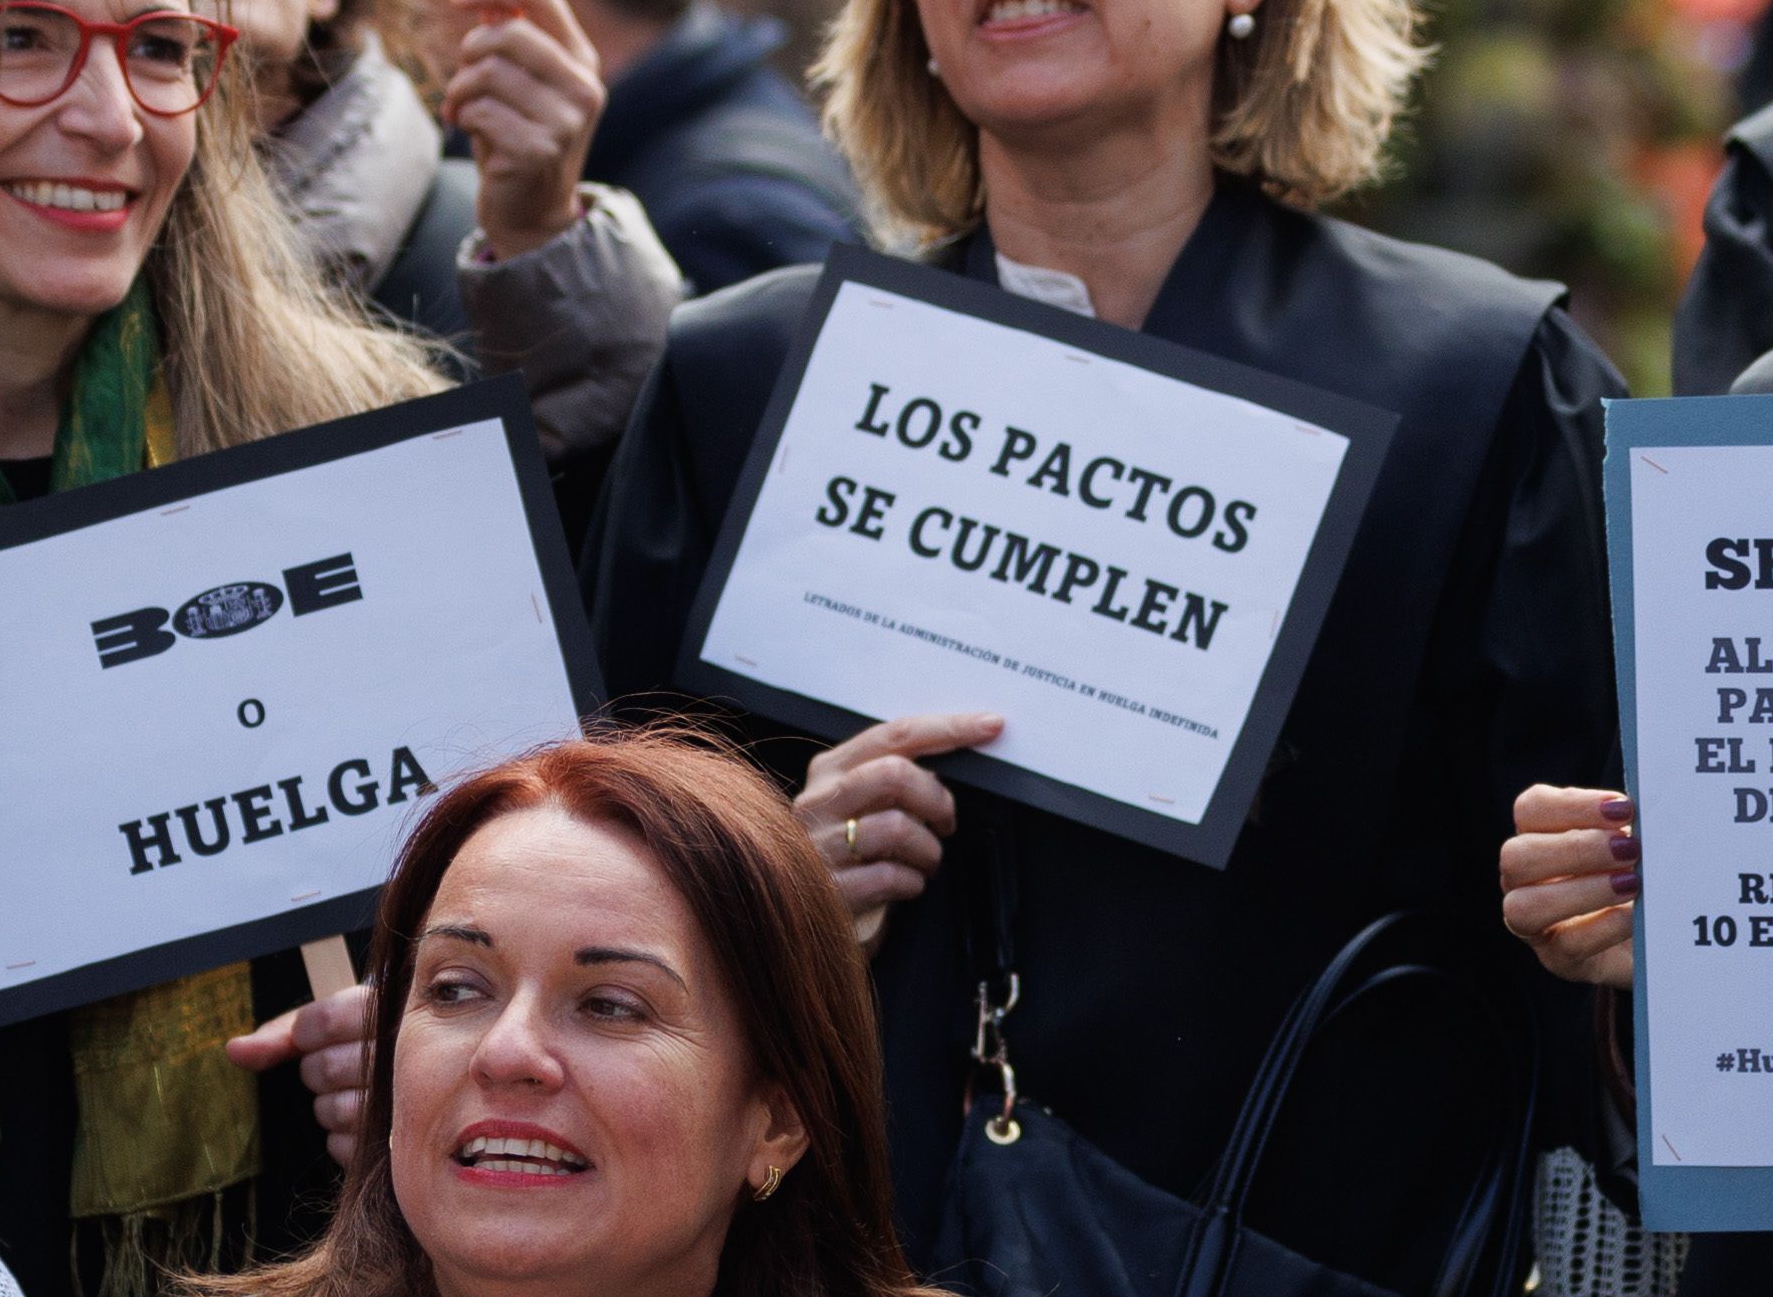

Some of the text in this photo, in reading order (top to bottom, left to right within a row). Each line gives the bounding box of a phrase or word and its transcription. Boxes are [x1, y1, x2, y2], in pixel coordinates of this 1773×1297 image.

[855, 383, 1257, 554] LOS PACTOS
[90, 552, 363, 670] BOE
[815, 475, 1229, 652] SE CUMPLEN
[803, 590, 1219, 740] LETRADOS DE LA ADMINISTRACIÓN DE JUSTICIA EN HUELGA INDEFINIDA
[119, 746, 438, 875] HUELGA
[1695, 737, 1756, 774] EL
[1692, 915, 1738, 948] 10
